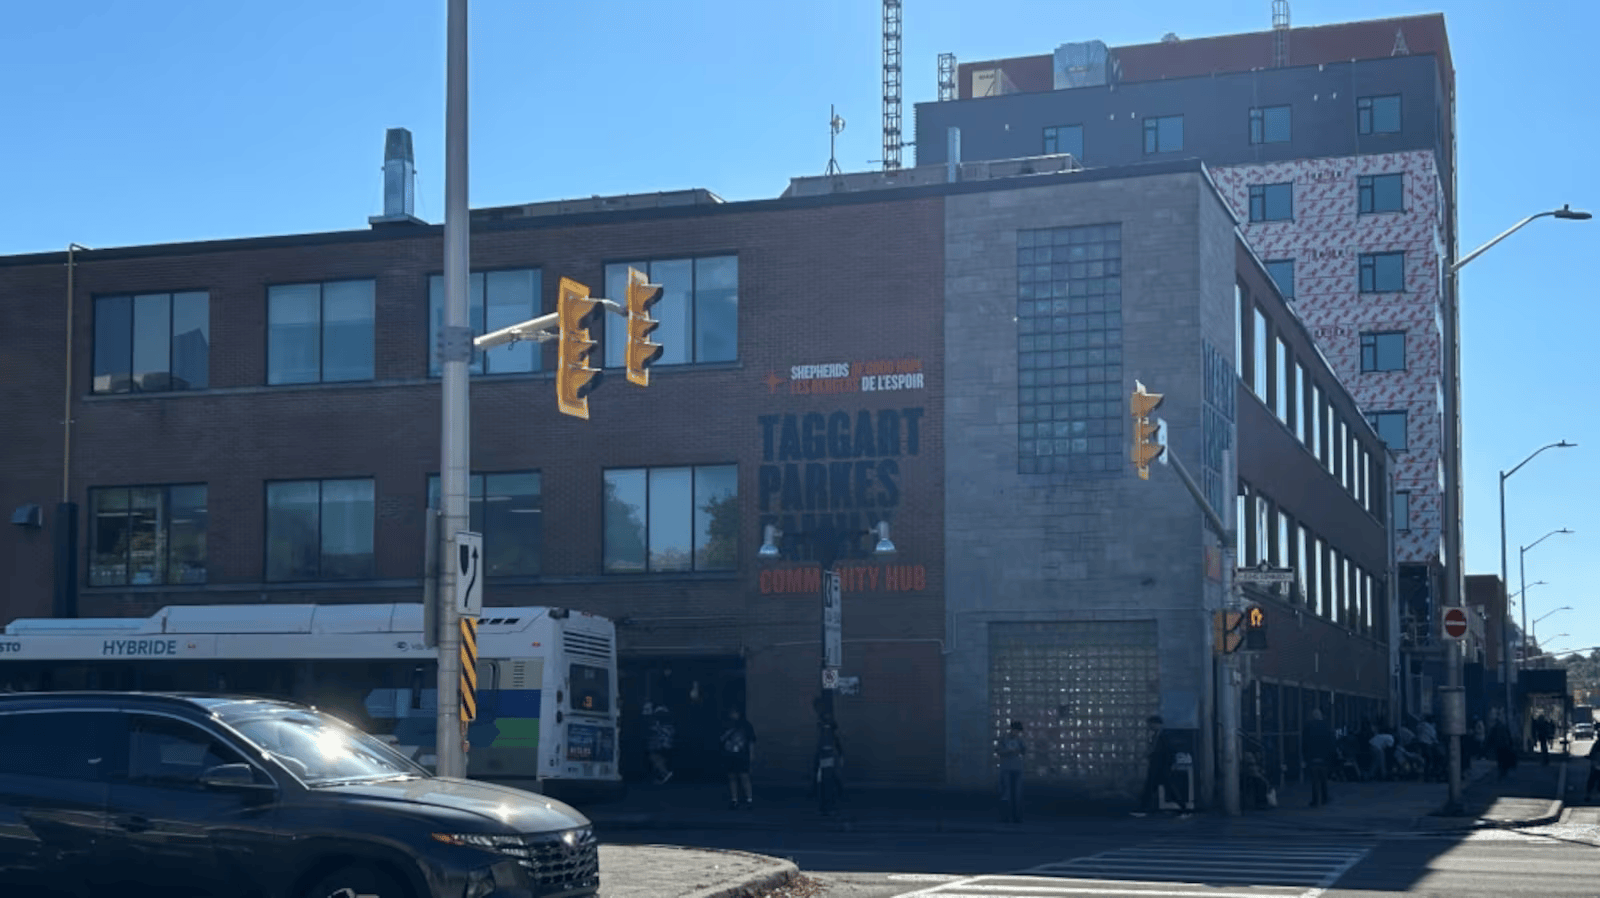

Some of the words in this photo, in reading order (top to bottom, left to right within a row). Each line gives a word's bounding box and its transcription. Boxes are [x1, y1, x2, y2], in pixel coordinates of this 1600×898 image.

[791, 362, 849, 380] SHEPHERDS
[861, 375, 875, 392] DE
[877, 373, 924, 391] L'ESPOIR
[758, 406, 924, 461] TAGGART
[758, 459, 900, 512] PARKES
[759, 566, 880, 594] COMMNITY
[885, 564, 927, 591] HUB
[102, 639, 177, 655] HYBRIDE
